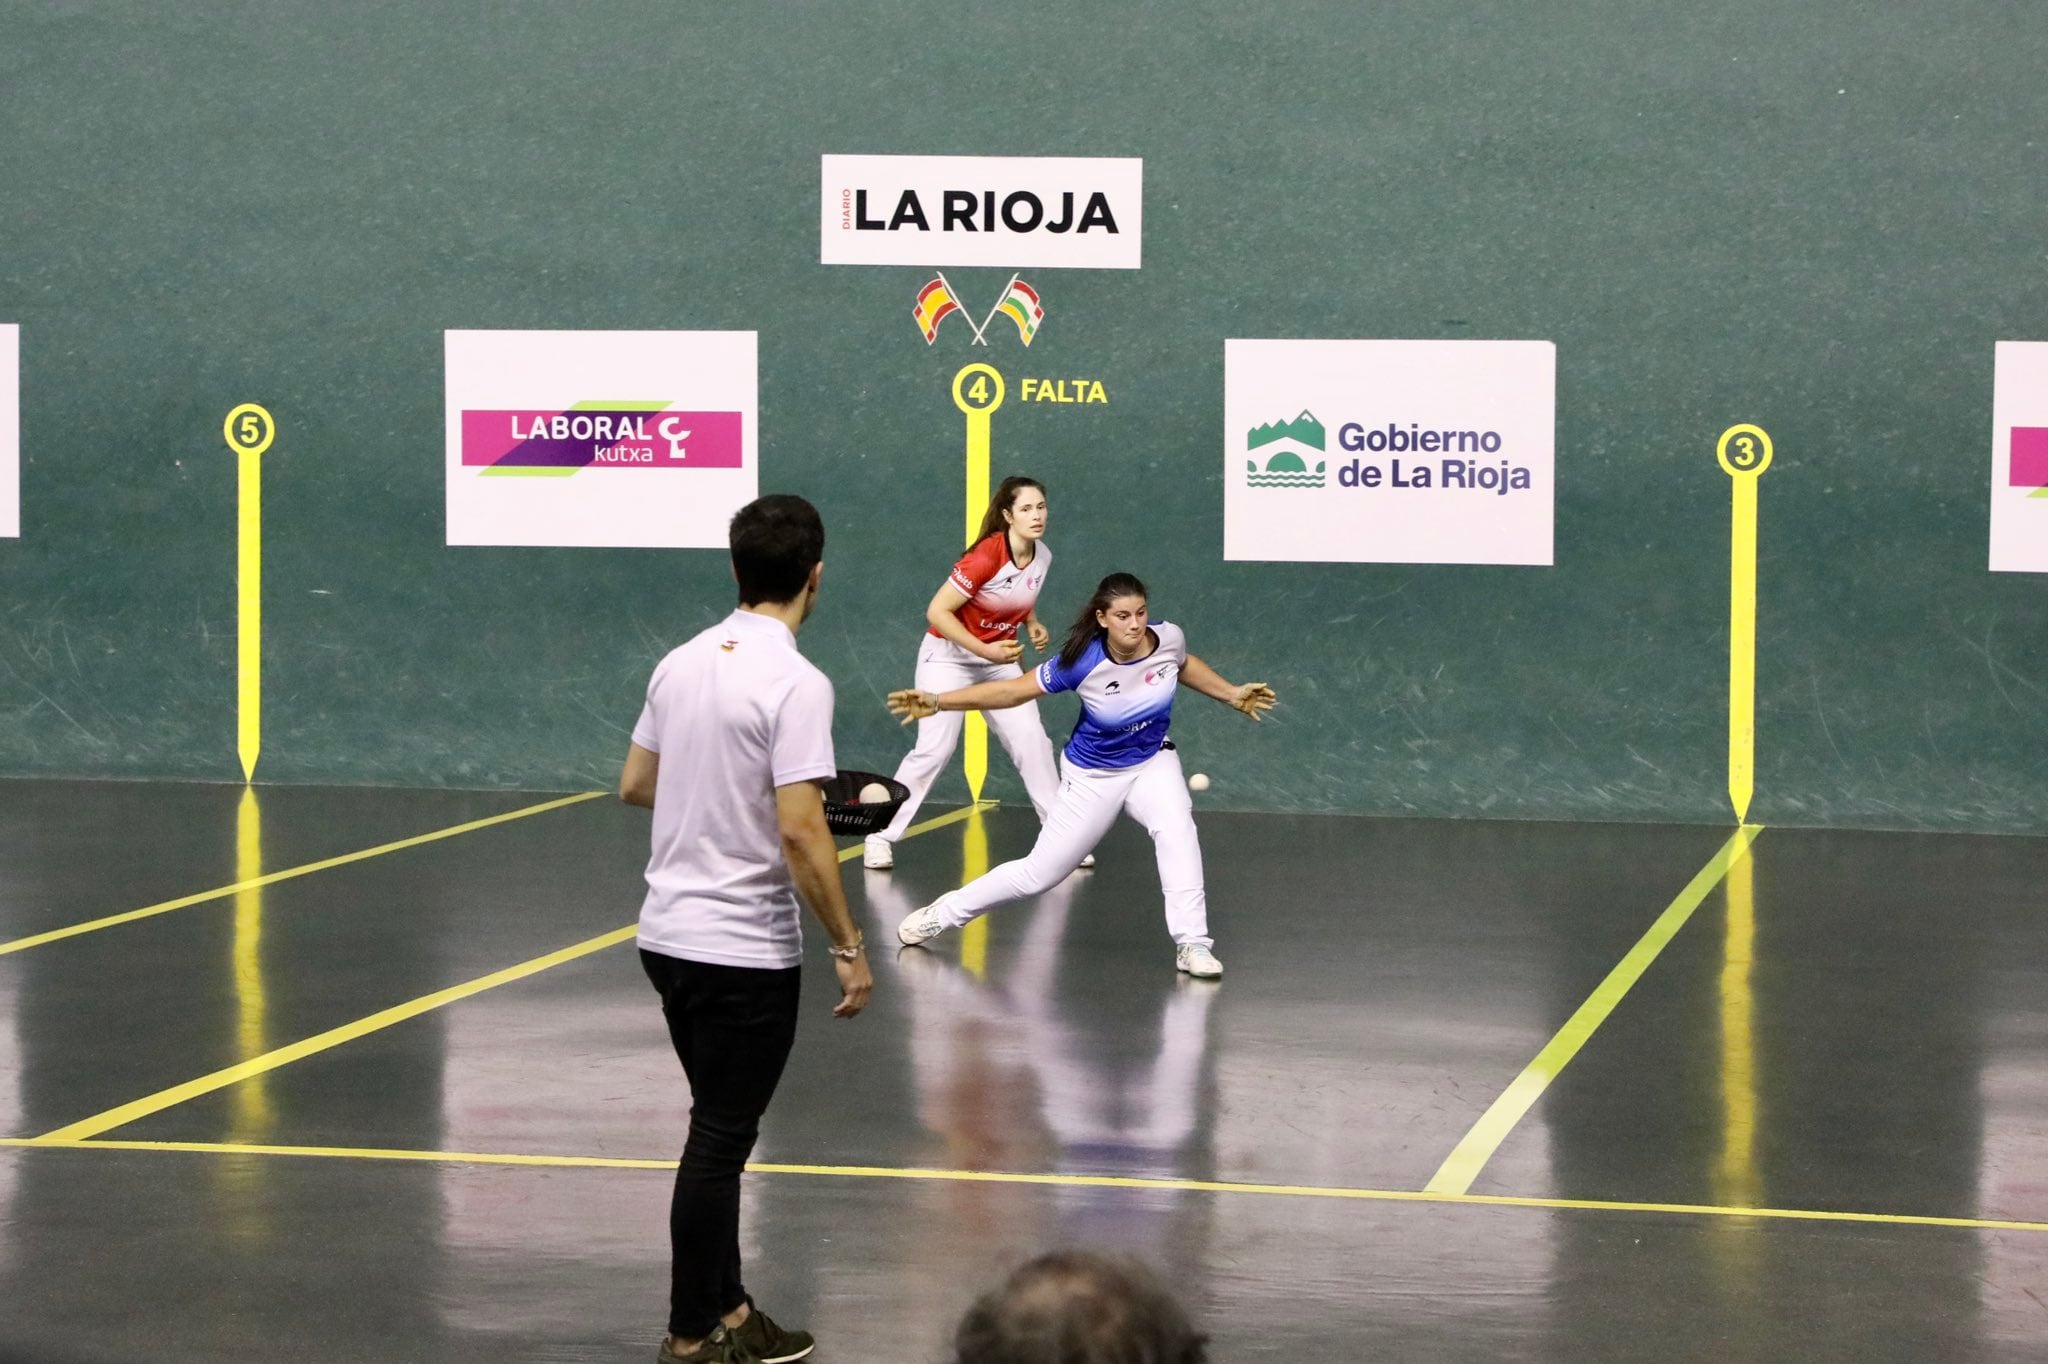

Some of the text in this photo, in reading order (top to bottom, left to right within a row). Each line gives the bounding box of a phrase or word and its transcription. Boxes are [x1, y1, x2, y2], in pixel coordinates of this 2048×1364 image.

[842, 188, 851, 230] DIARIO
[855, 189, 1120, 234] LA RIOJA
[968, 376, 1108, 404] 4 FALTA
[240, 416, 259, 443] 5
[511, 415, 653, 441] LABORAL
[1338, 422, 1502, 453] Gobierno
[594, 444, 653, 462] kutxa
[1735, 437, 1754, 465] 3
[1338, 459, 1531, 496] de La Rioja
